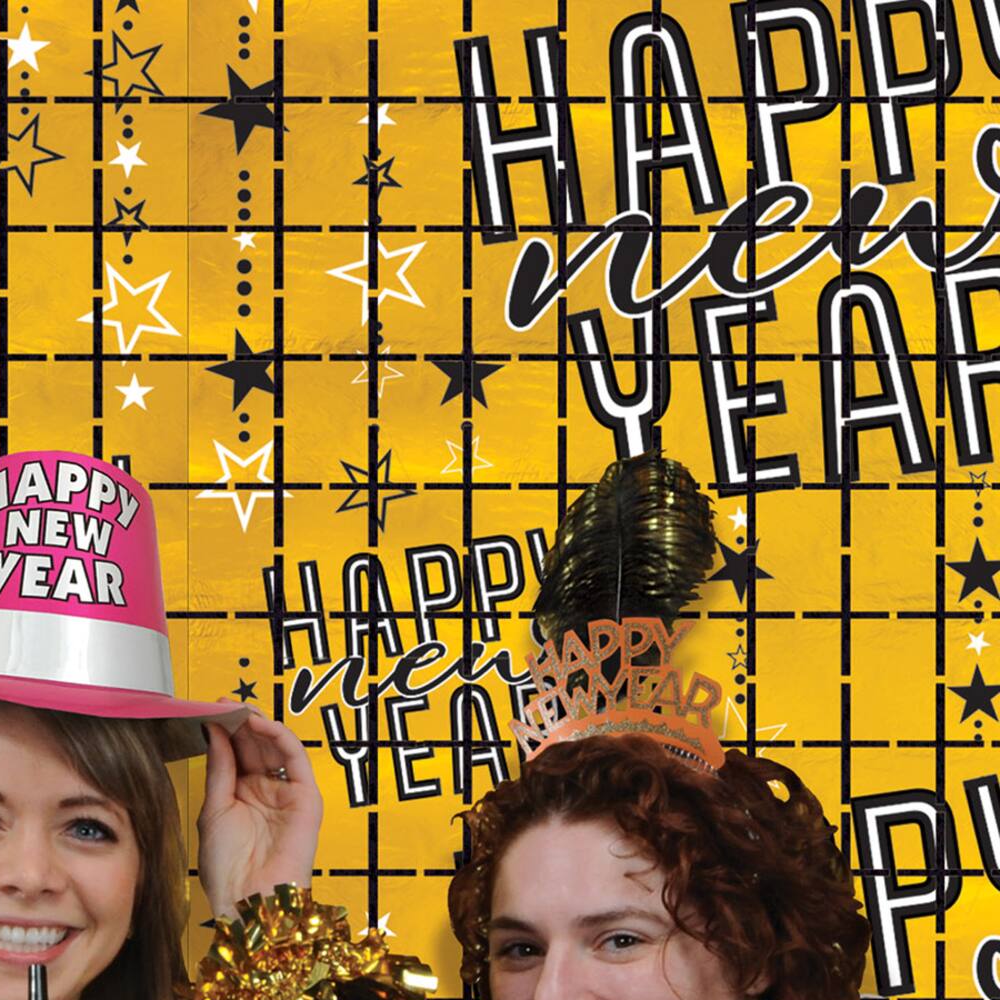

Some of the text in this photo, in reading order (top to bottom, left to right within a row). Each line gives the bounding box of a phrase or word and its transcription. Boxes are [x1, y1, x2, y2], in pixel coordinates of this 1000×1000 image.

[454, 0, 1000, 246] HAPP
[3, 507, 114, 557] NEW
[525, 617, 697, 693] HAPPY
[588, 666, 722, 729] YEAR
